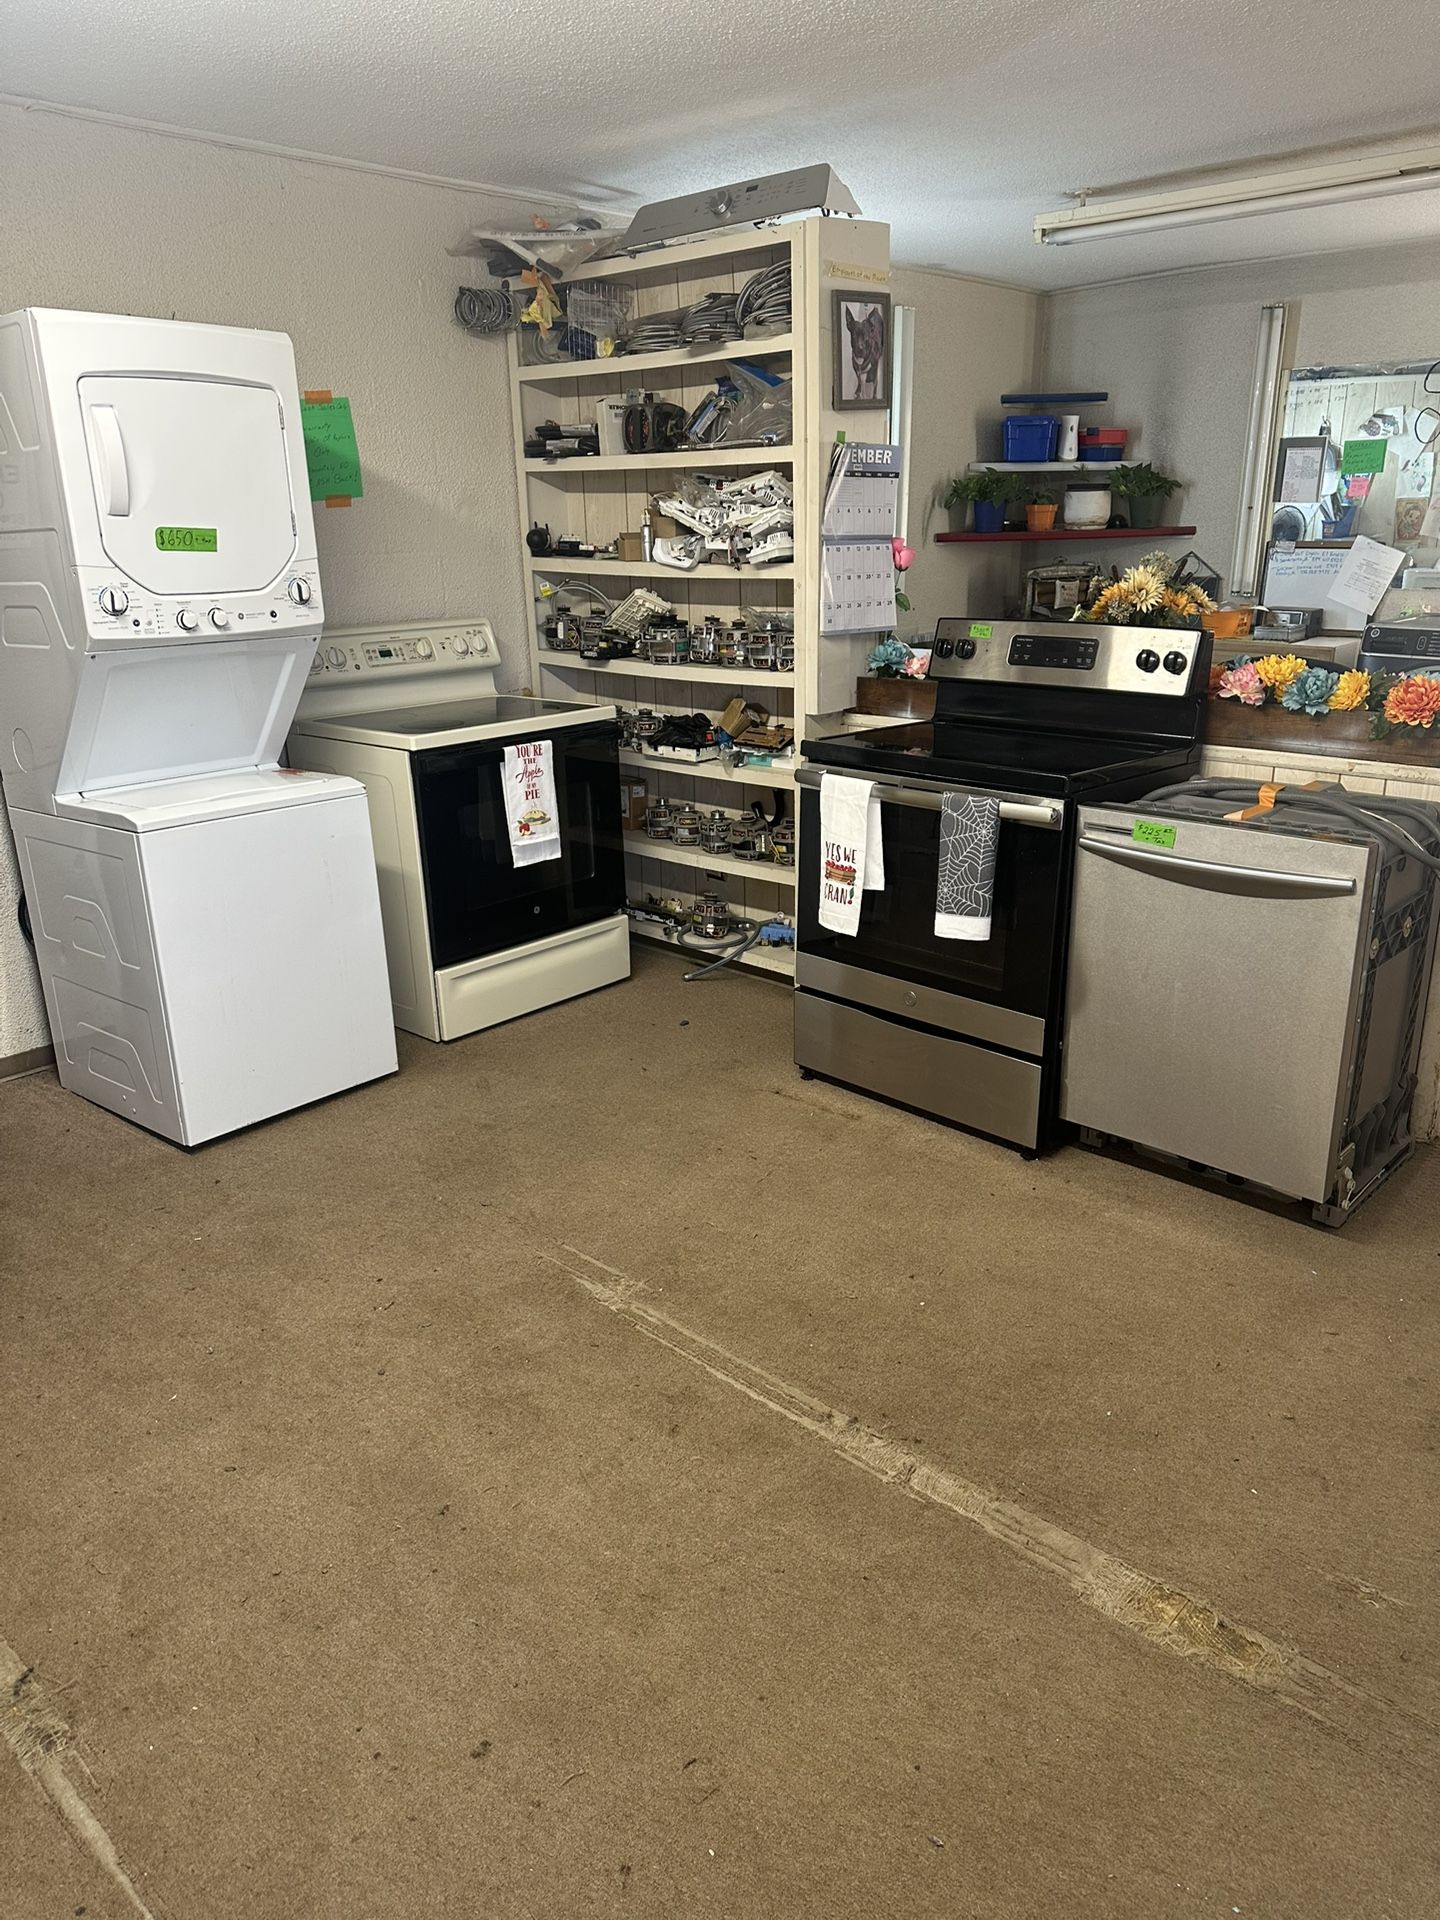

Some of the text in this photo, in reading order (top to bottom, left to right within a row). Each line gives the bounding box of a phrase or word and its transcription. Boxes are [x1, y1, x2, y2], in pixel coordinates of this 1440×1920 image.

[160, 530, 193, 546] $650
[525, 789, 540, 800] PIE
[1138, 823, 1162, 837] $225
[825, 841, 857, 864] YES WE
